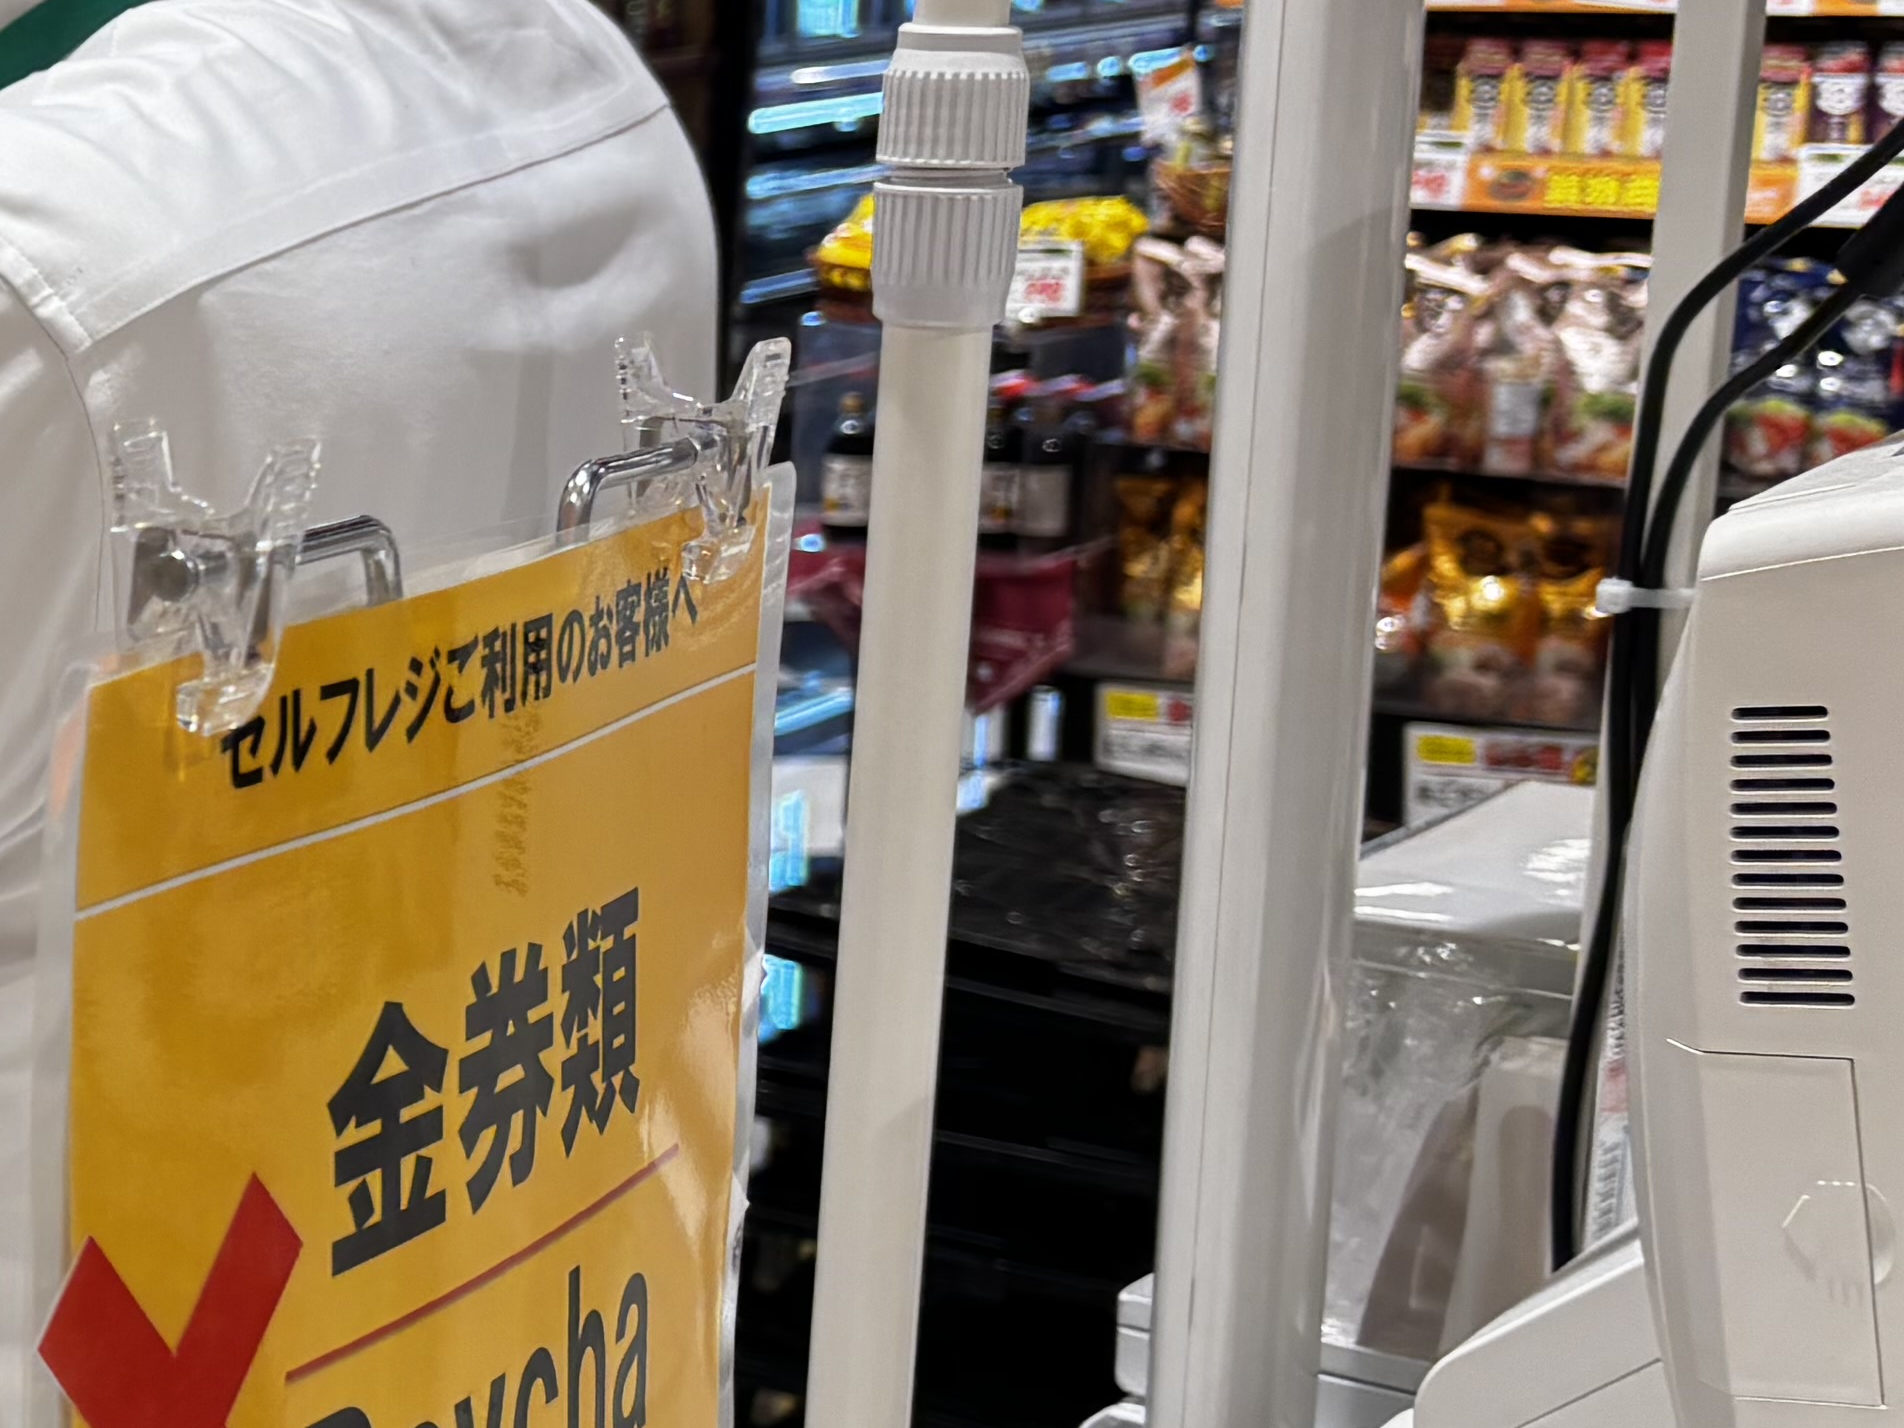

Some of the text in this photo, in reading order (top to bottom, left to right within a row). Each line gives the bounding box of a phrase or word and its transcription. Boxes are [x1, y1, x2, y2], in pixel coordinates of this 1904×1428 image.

[219, 567, 699, 790] セルフレジご利用のお客様へ
[327, 887, 641, 1277] 金券類
